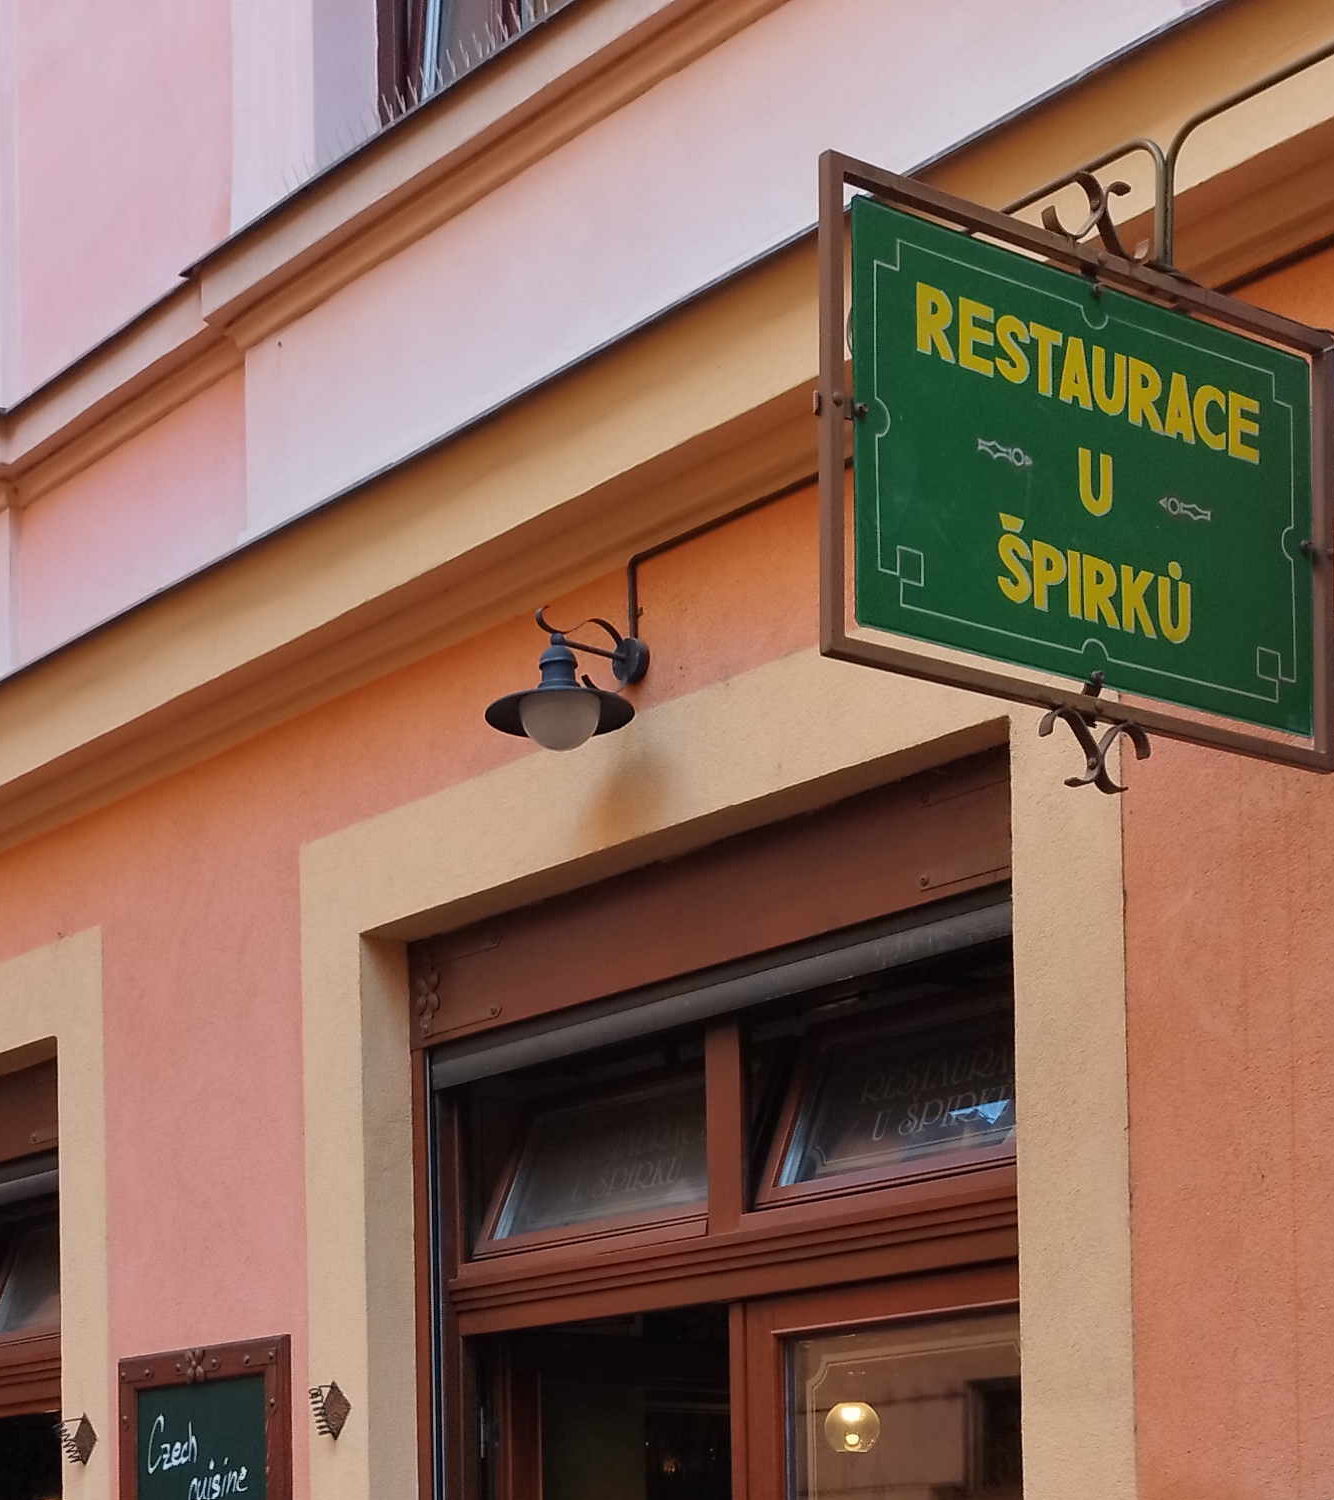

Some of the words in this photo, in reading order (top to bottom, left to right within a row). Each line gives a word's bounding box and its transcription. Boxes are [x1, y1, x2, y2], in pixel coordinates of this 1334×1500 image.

[915, 281, 1261, 465] RESTAURACE
[1078, 446, 1114, 517] U
[996, 512, 1192, 645] ŠPIRKŮ
[148, 1413, 198, 1475] Czech
